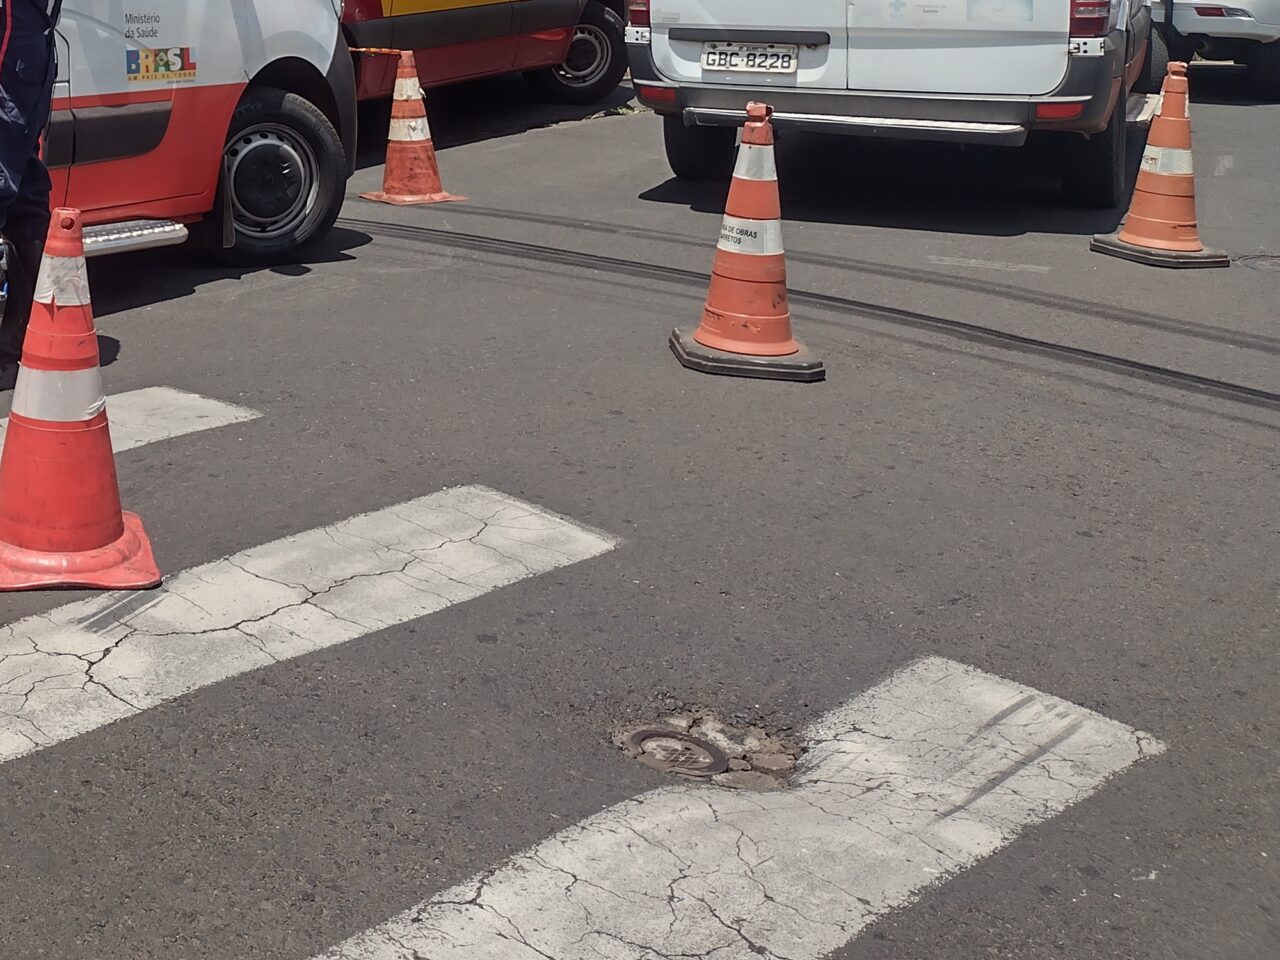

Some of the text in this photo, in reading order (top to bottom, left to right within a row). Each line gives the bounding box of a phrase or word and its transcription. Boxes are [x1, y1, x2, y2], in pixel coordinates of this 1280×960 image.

[124, 12, 160, 24] Ministério
[124, 26, 159, 38] da Saúde
[735, 227, 758, 239] OBRAS
